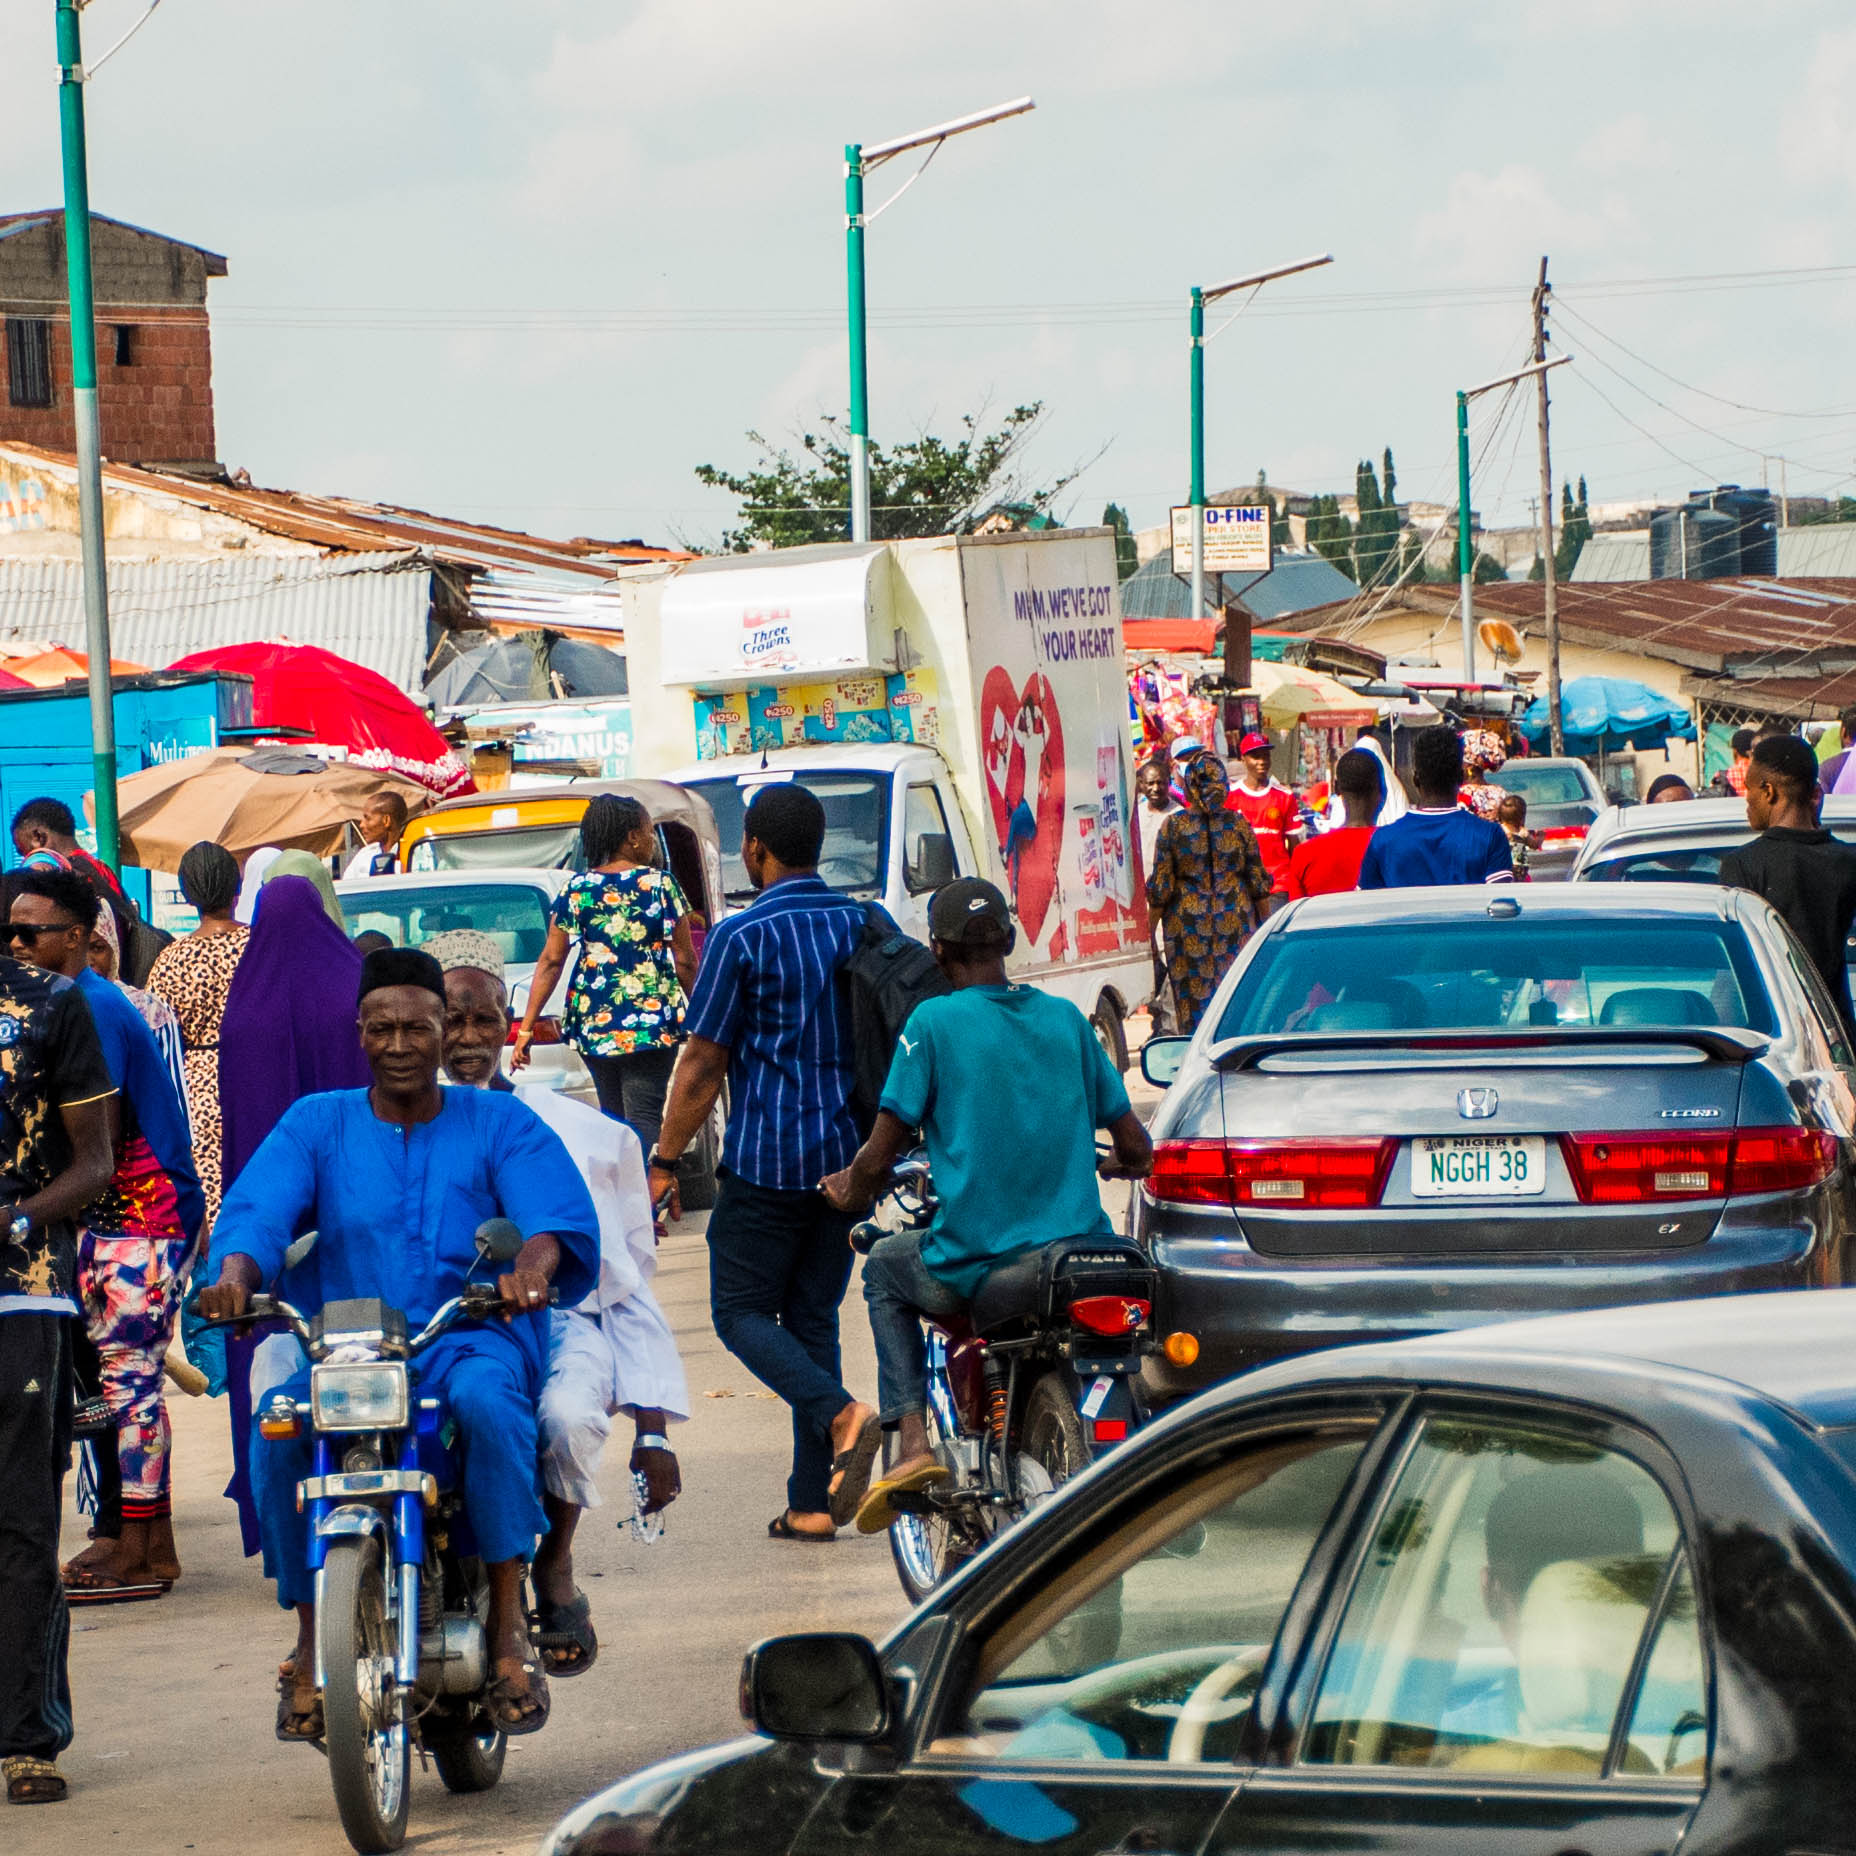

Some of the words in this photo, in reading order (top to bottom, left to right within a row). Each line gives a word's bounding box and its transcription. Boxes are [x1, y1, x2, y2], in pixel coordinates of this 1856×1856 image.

[1088, 585, 1111, 617] GOT
[743, 635, 791, 655] Crowns
[752, 625, 789, 645] Three
[1042, 629, 1078, 661] YOUR
[1078, 627, 1115, 659] HEART
[1452, 1138, 1508, 1148] NIGER
[1431, 1150, 1491, 1183] NGGH
[1498, 1149, 1529, 1182] 38
